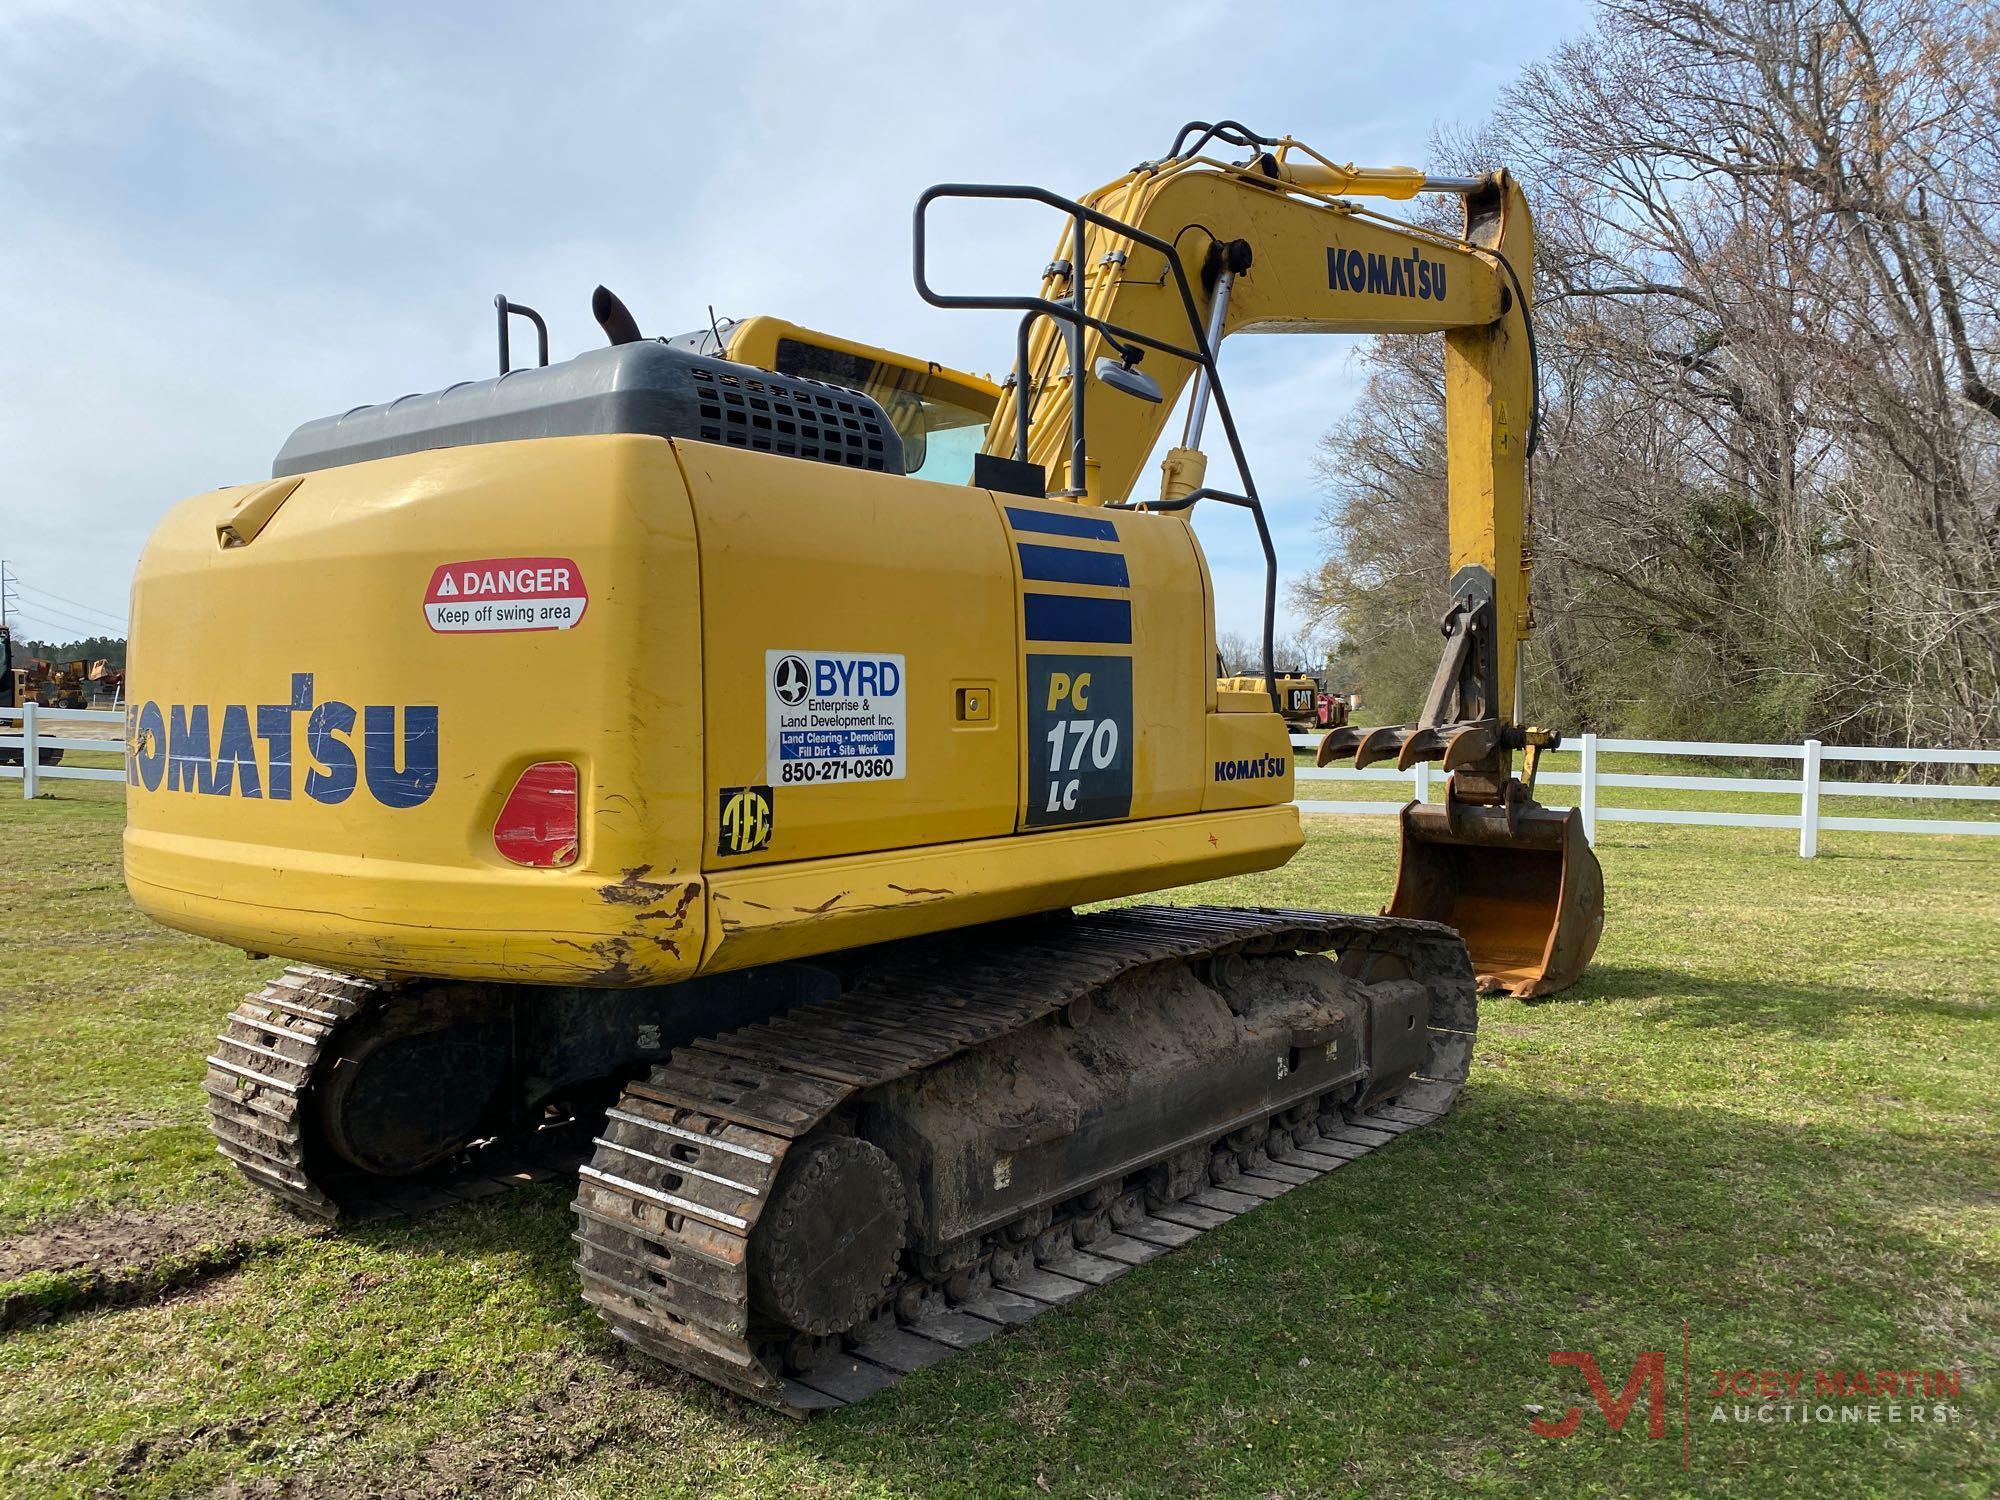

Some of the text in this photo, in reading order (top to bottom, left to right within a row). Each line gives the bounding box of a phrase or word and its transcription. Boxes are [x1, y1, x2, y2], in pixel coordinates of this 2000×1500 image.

[1326, 246, 1447, 302] KOMATSU
[463, 568, 570, 595] DANGER
[437, 604, 571, 625] Keep off swing area
[815, 659, 900, 697] BYRD
[1046, 672, 1091, 712] PC
[1293, 690, 1312, 710] CAT
[808, 698, 870, 713] Enterprise &
[781, 714, 894, 729] Land Development Inc.
[782, 733, 804, 744] Land
[806, 732, 842, 745] Clearing
[850, 731, 894, 742] Demolition
[798, 746, 812, 757] Fill
[814, 746, 831, 756] Dirt
[839, 745, 855, 756] Site
[858, 744, 879, 755] Work
[1047, 718, 1119, 772] 170
[782, 758, 894, 783] 850-271-0360
[1215, 753, 1285, 781] KOMATSU
[1046, 778, 1080, 812] LC
